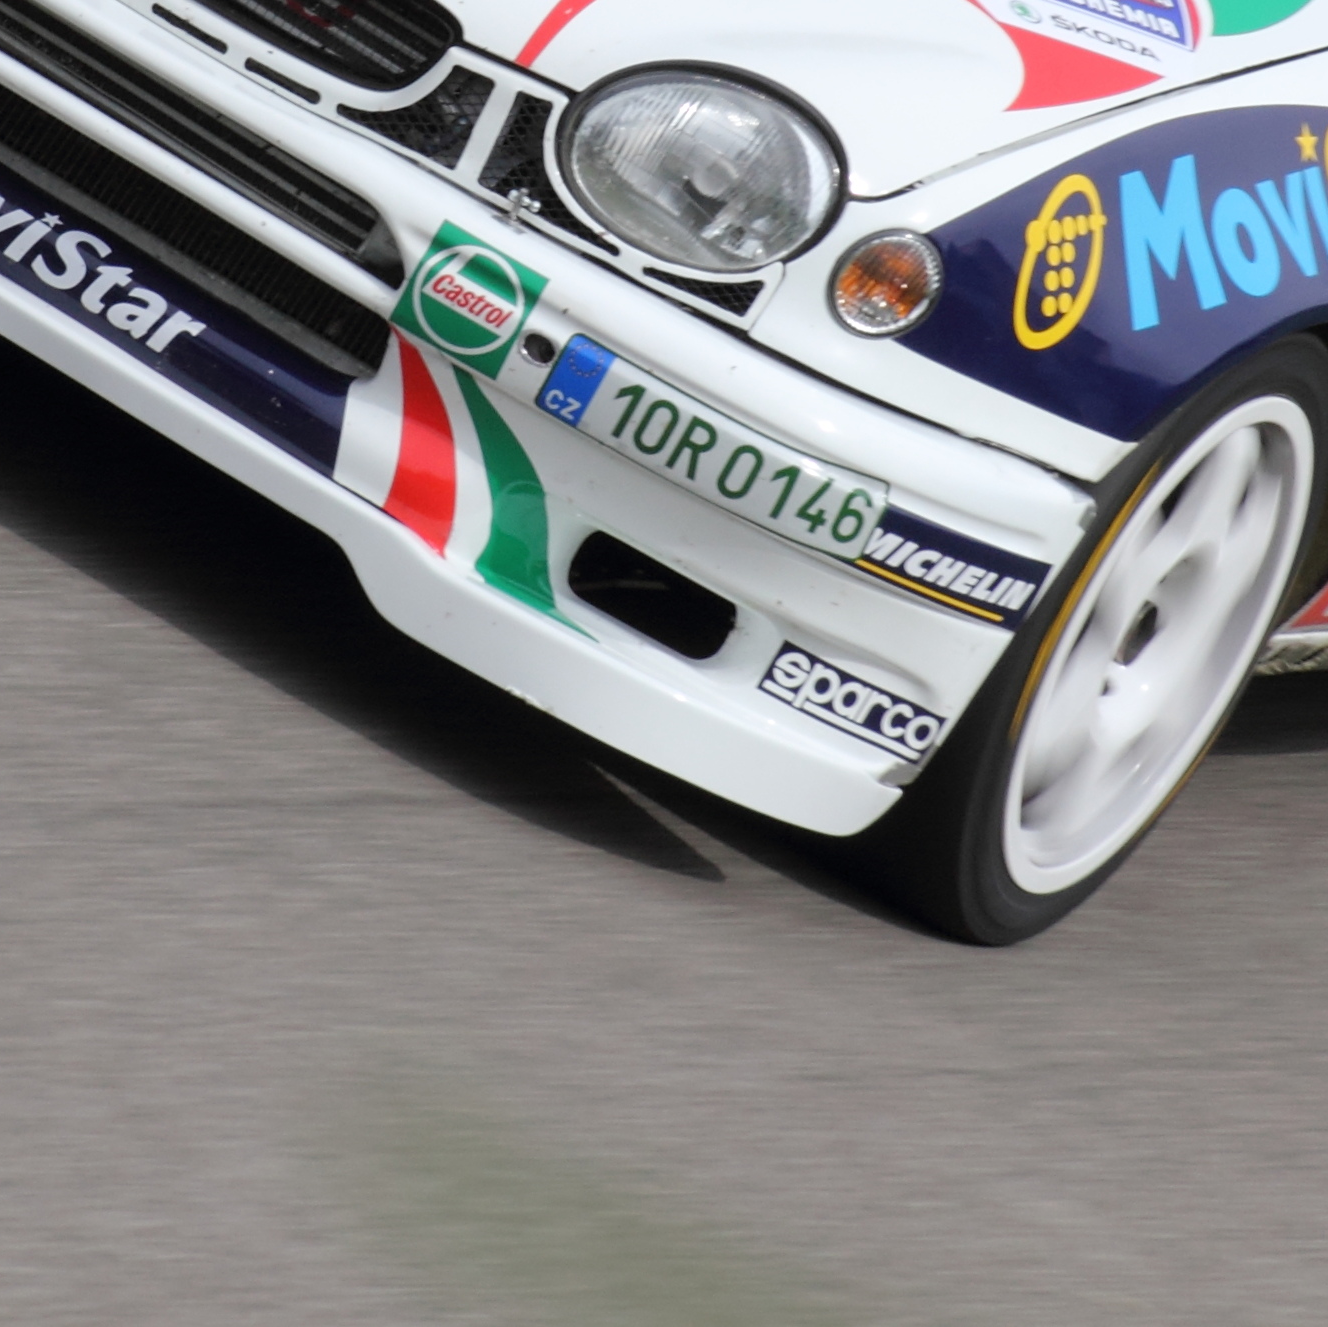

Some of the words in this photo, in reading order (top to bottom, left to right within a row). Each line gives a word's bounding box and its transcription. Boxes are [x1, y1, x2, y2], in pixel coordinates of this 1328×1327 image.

[1049, 14, 1161, 62] ŠKODA
[432, 274, 514, 328] Castrol
[545, 388, 581, 419] CZ
[612, 384, 715, 482] 10R
[716, 444, 875, 543] 0146
[864, 527, 1037, 611] MICHELIN
[773, 652, 940, 752] sparco
